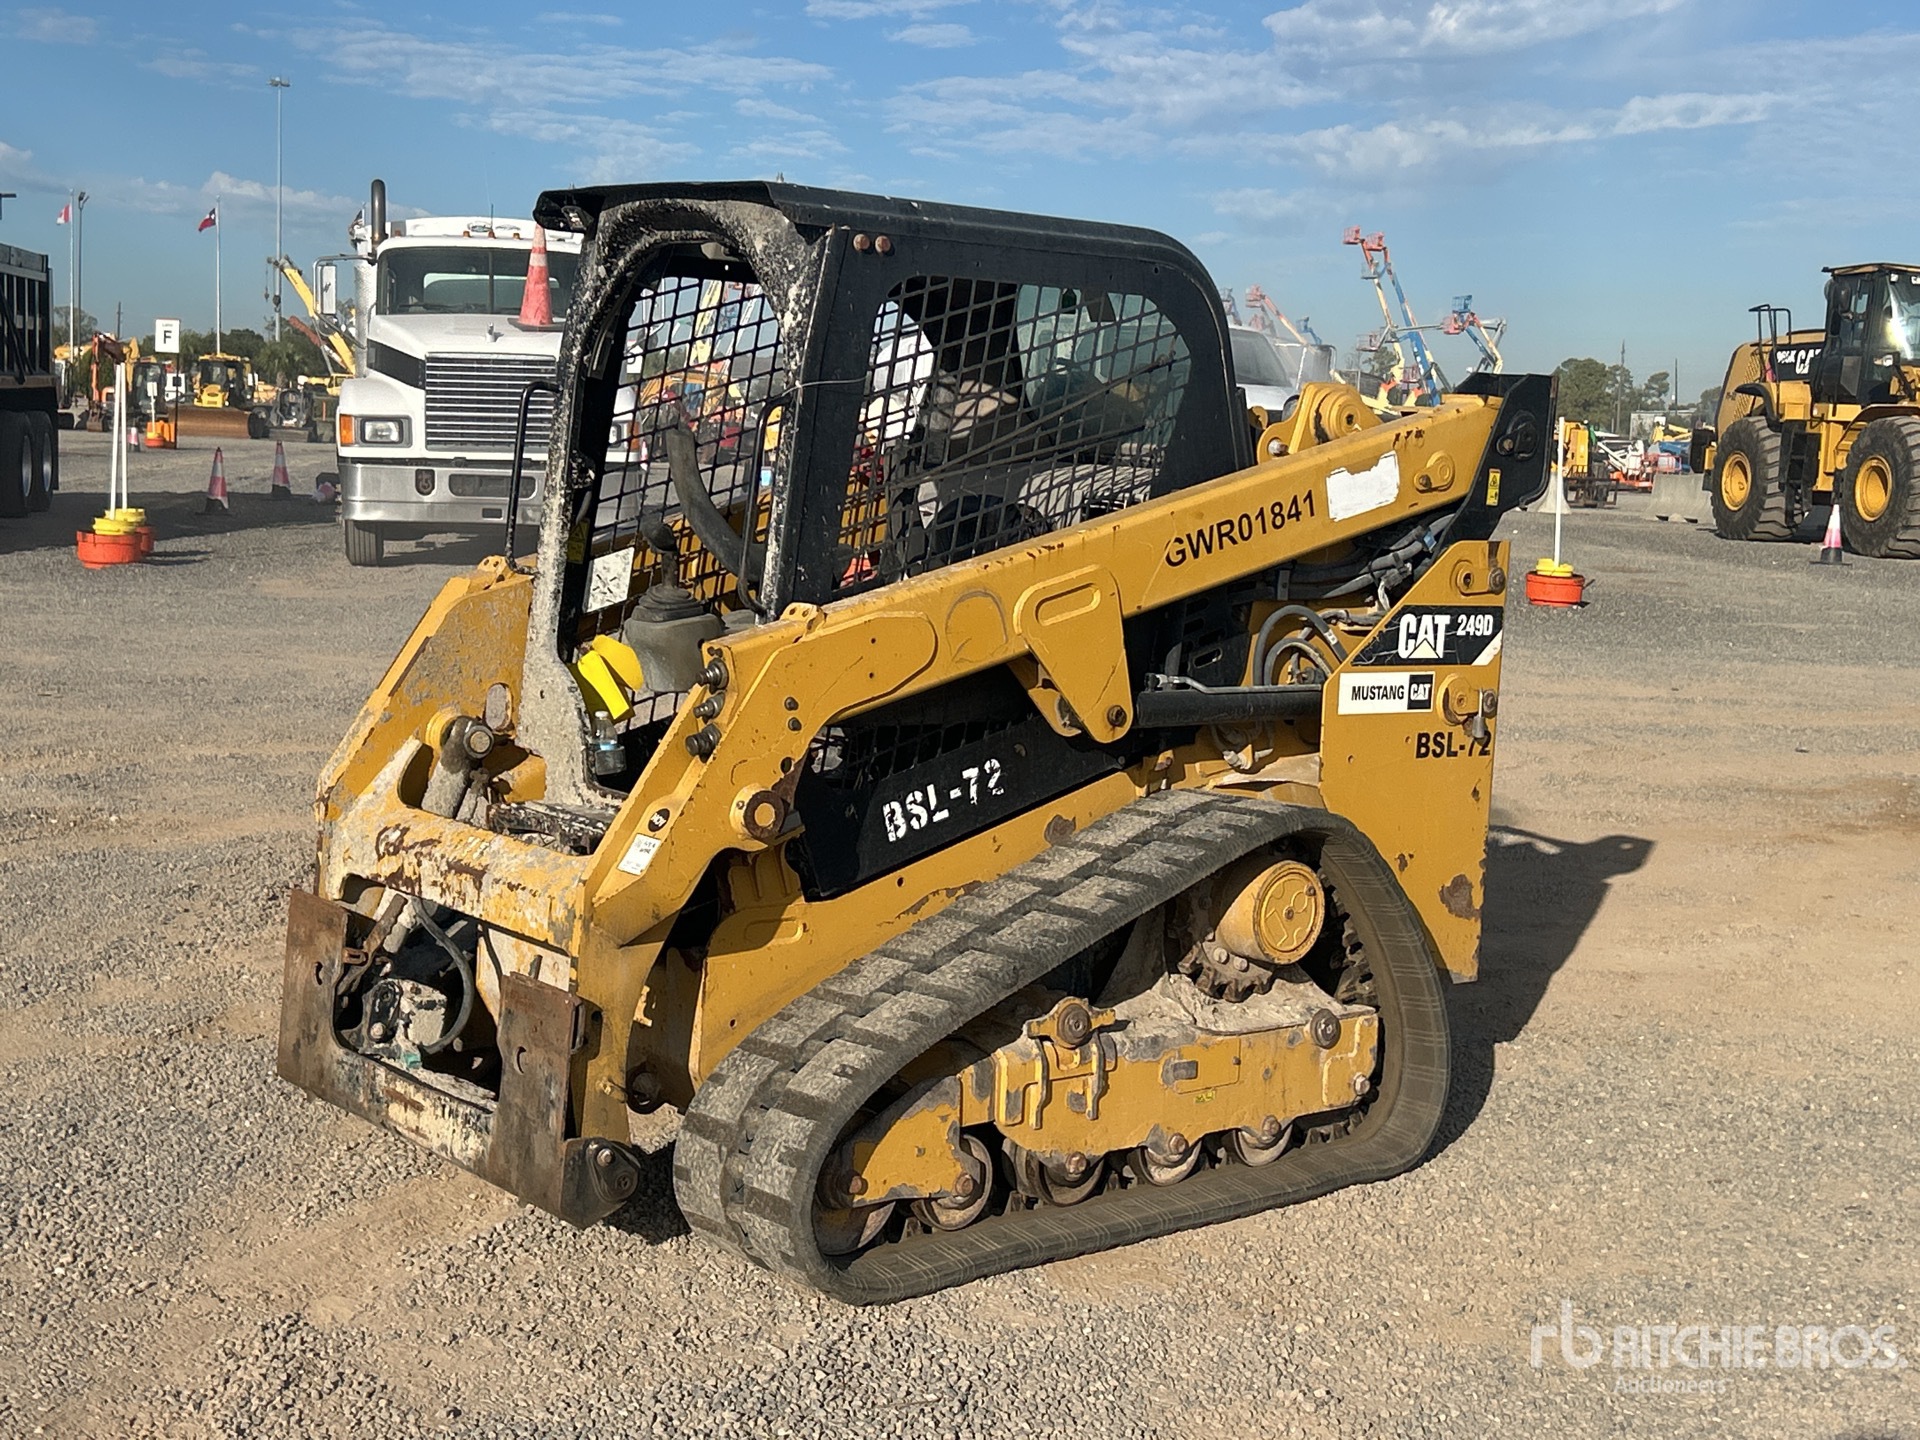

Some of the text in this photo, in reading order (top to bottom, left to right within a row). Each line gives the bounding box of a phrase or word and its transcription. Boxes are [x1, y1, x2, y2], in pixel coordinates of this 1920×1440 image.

[163, 330, 173, 344] F
[1164, 489, 1315, 567] GWR01841
[1398, 613, 1494, 659] CAT 249D
[1351, 683, 1431, 700] MUSTANG CAT
[882, 759, 1005, 842] BSL-72
